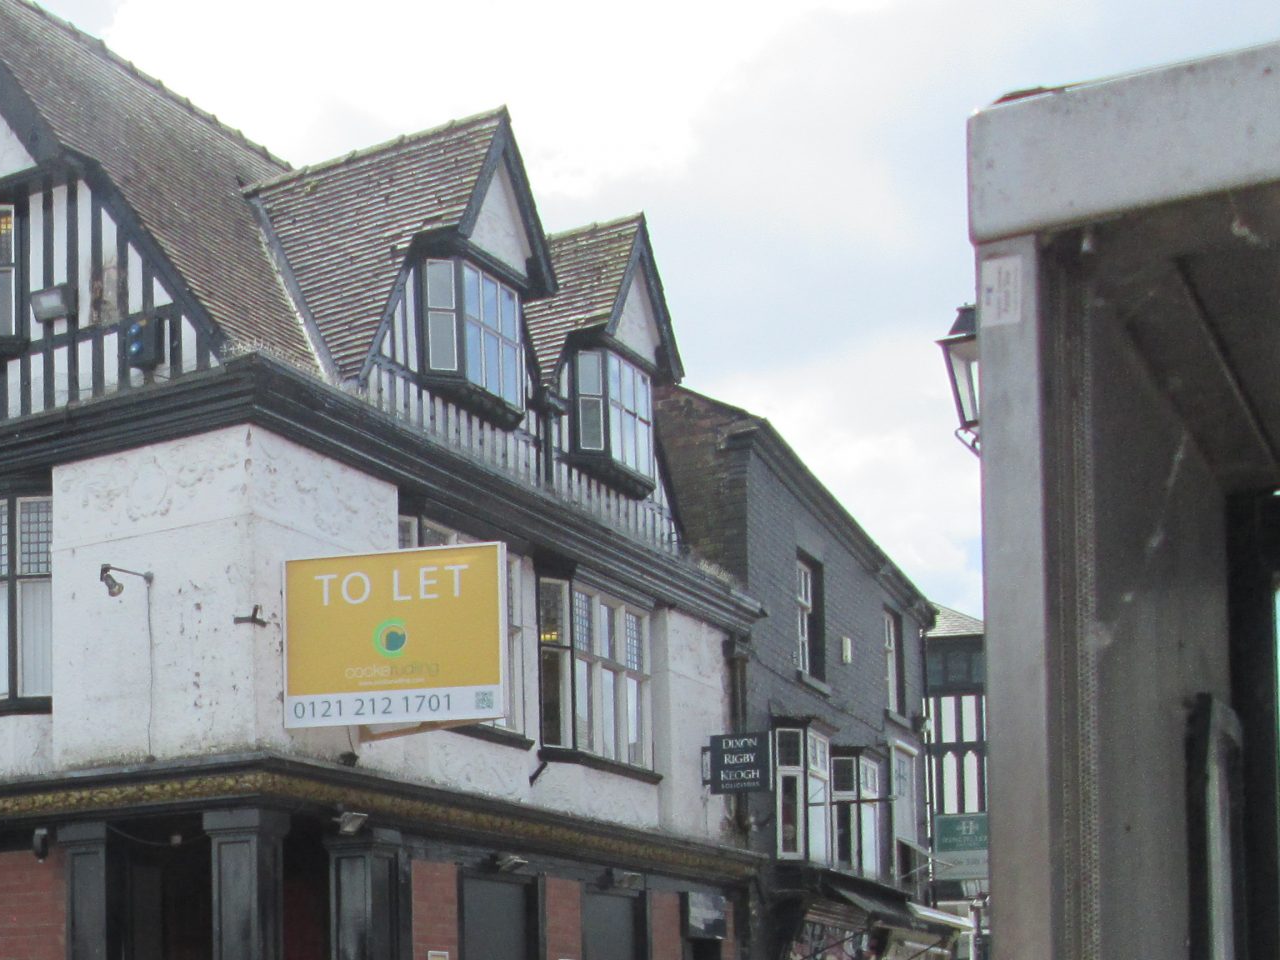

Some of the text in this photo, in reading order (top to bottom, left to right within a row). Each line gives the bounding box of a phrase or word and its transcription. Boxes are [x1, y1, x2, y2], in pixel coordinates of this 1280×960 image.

[314, 564, 469, 606] TO LET
[293, 693, 452, 719] 0121 212 1701
[722, 737, 758, 750] DIXON
[724, 752, 756, 765] RIGBY
[720, 769, 760, 781] KEOGH
